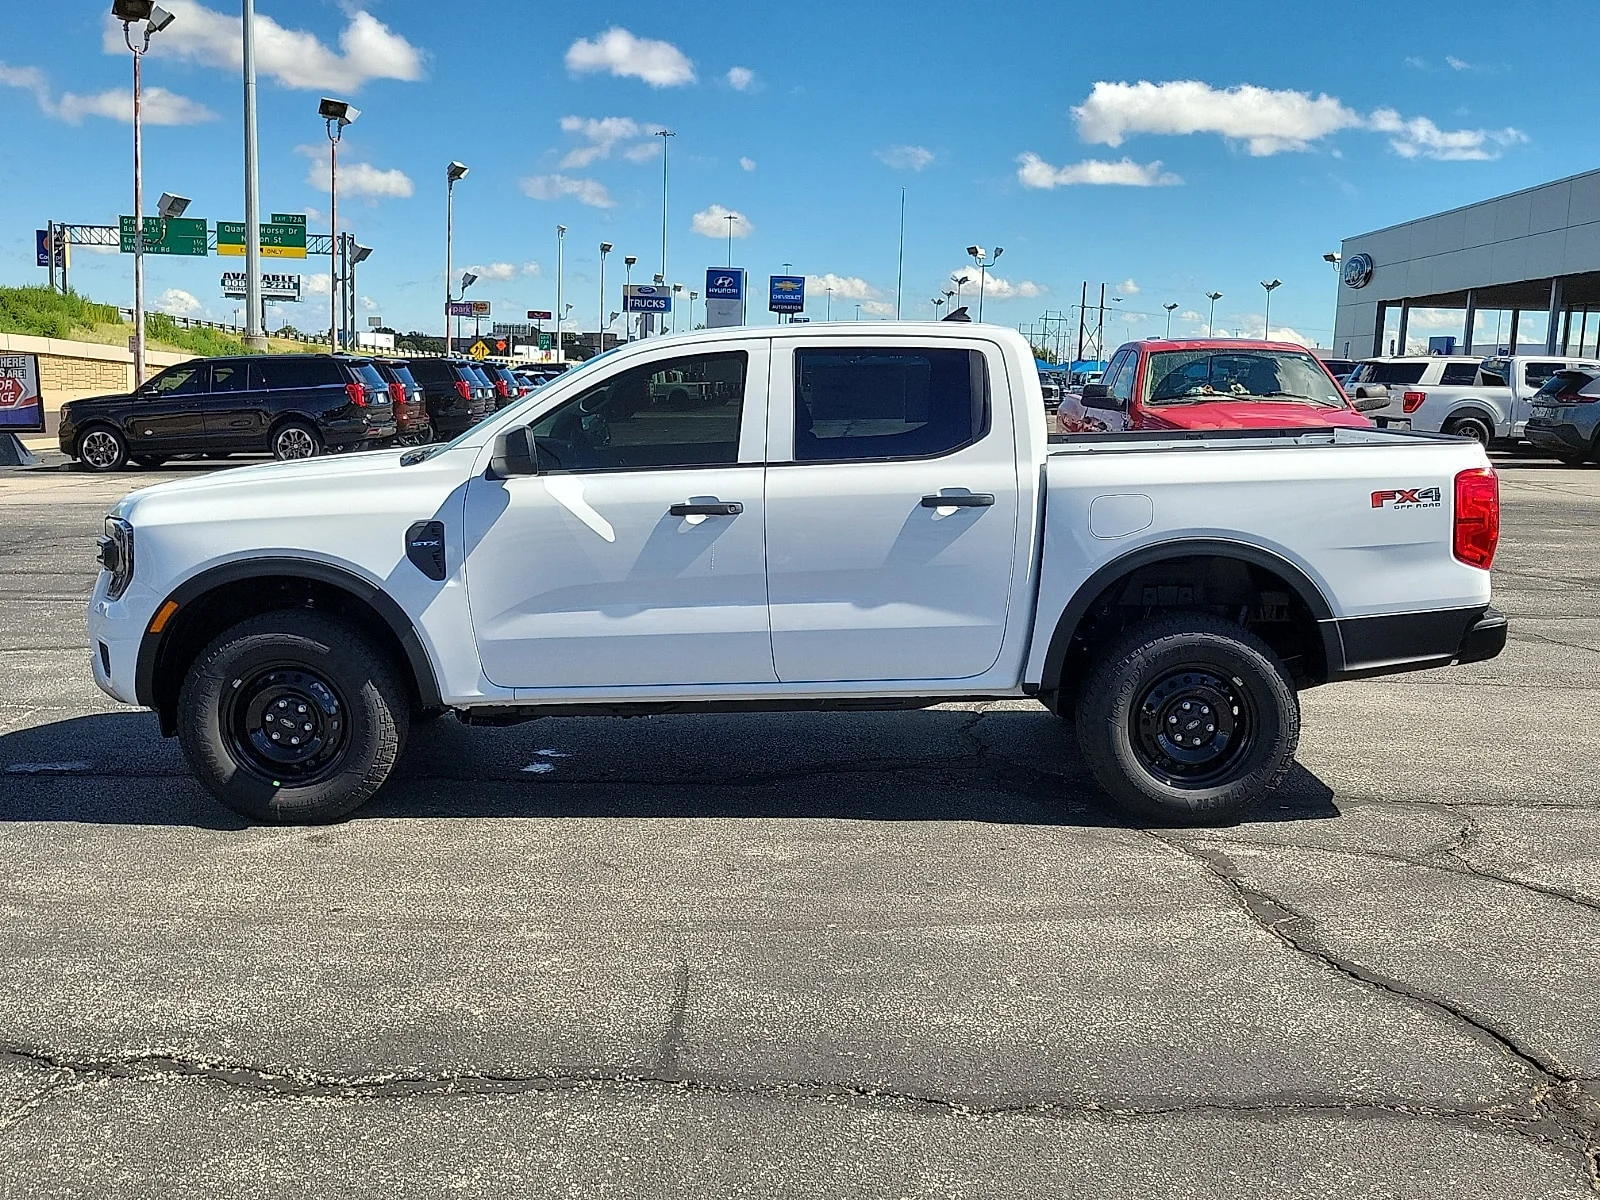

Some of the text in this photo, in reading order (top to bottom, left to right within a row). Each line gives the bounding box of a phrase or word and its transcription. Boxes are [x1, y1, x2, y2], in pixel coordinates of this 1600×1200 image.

[224, 225, 298, 235] Quar Horse Dr
[241, 235, 282, 244] Non St
[222, 272, 297, 282] AVAABLE
[630, 298, 666, 309] TRUCKS
[452, 305, 471, 314] park
[7, 369, 26, 379] ARE!
[1371, 487, 1441, 508] FX4
